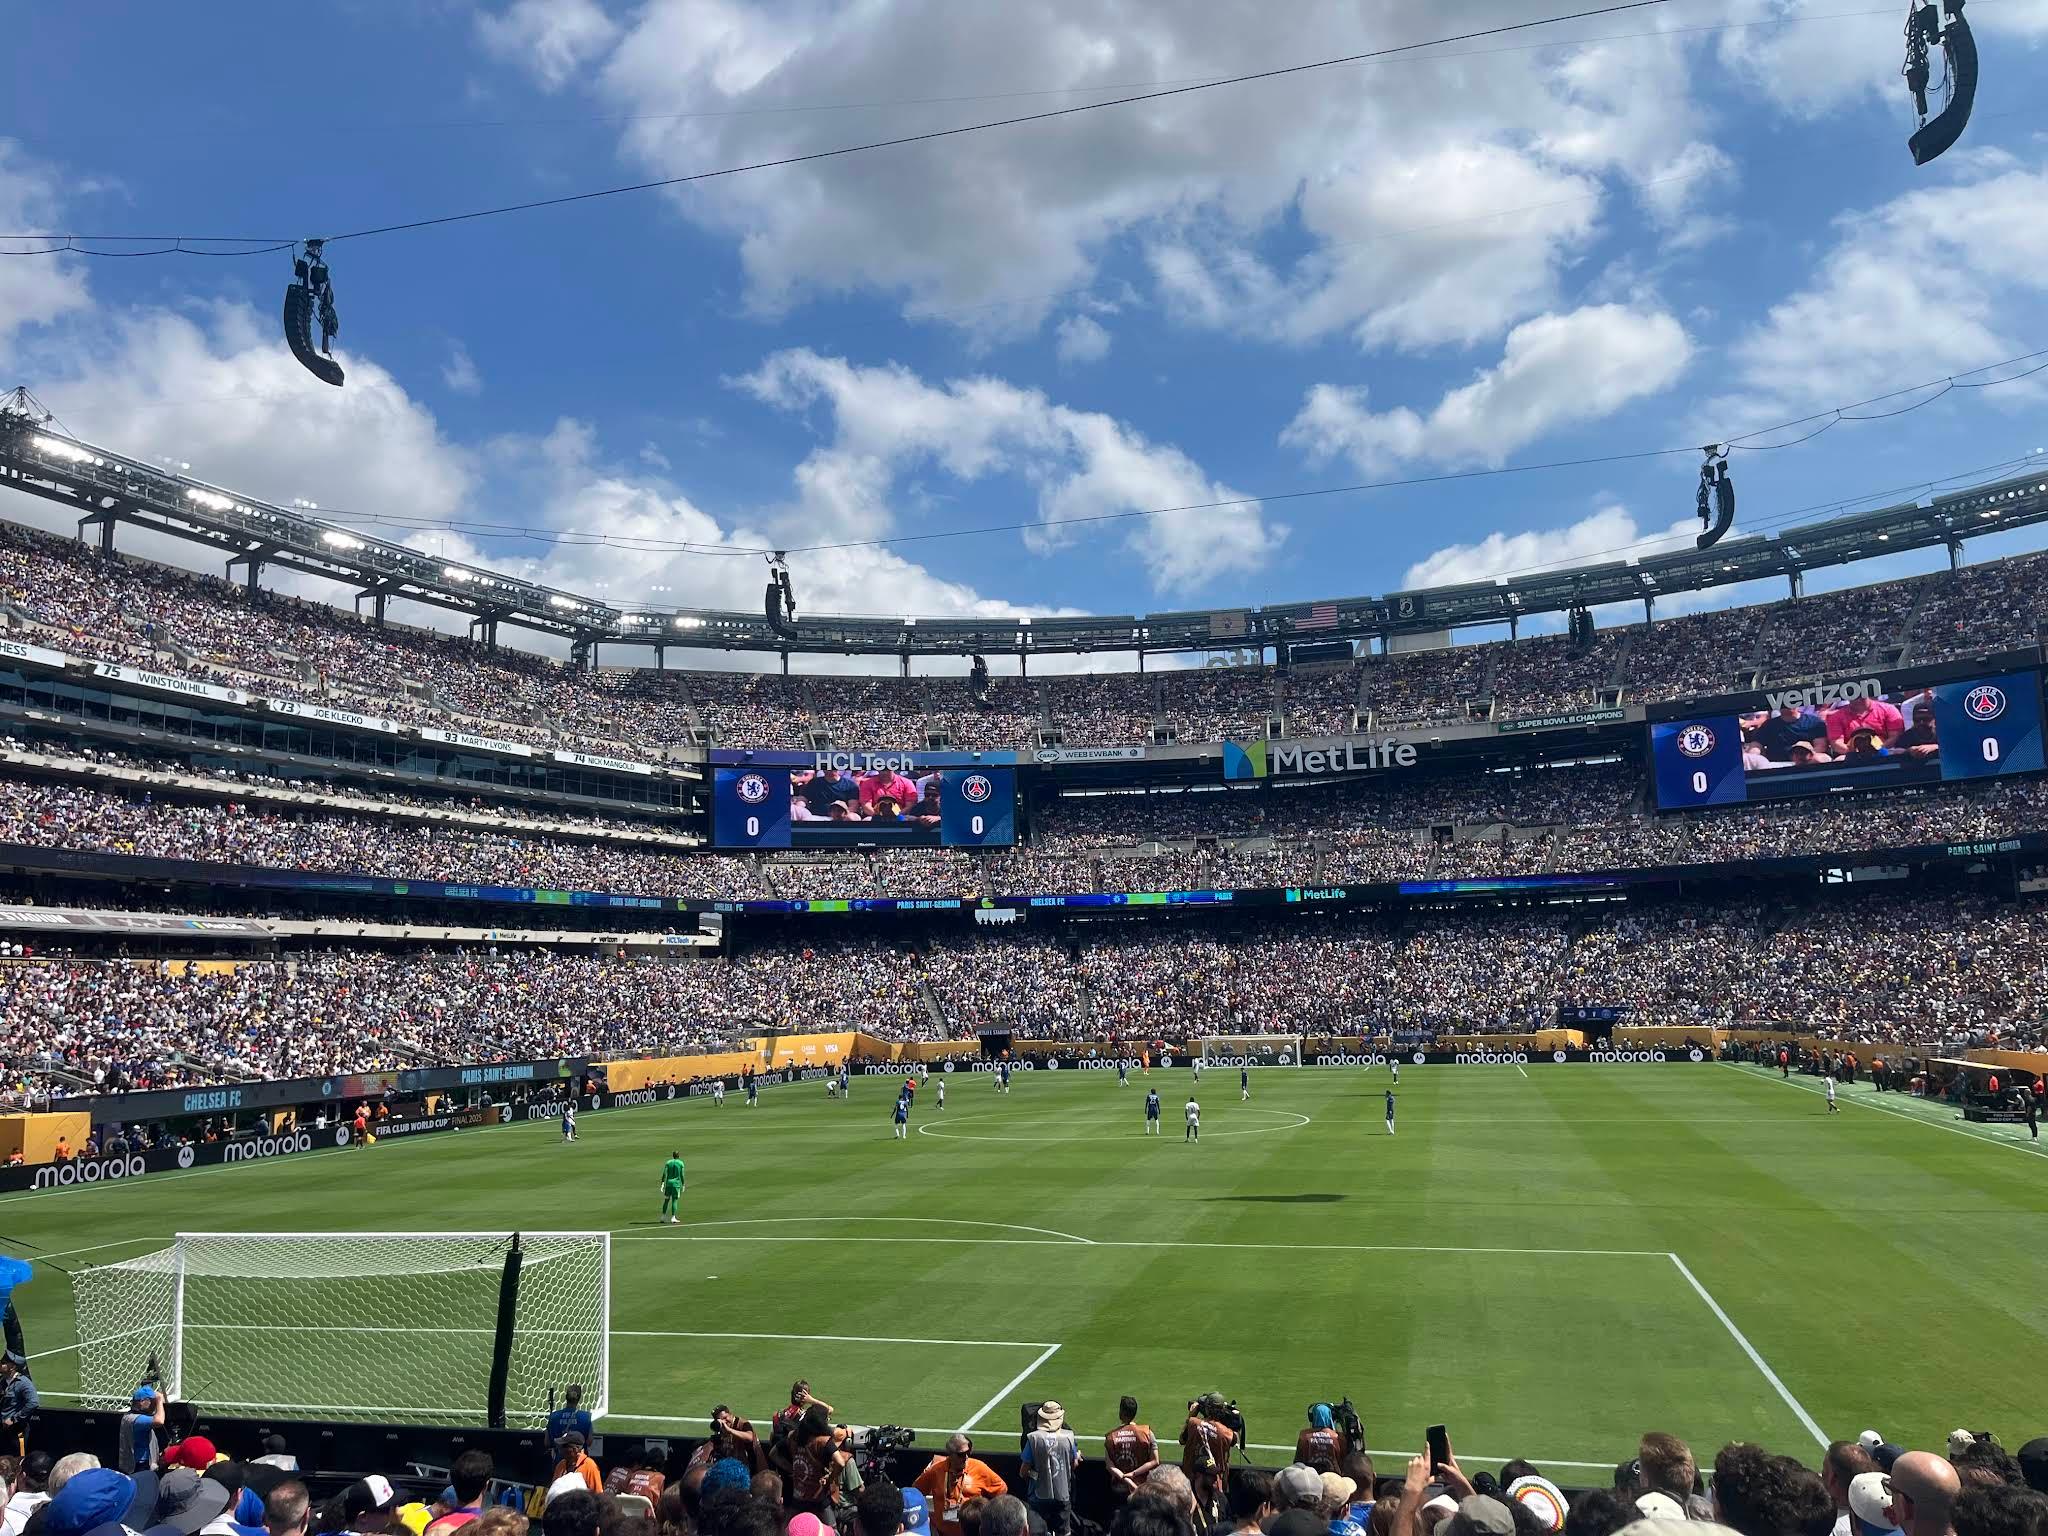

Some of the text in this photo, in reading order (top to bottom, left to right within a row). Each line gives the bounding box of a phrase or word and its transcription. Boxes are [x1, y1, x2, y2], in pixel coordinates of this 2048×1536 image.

[0, 641, 27, 657] HESS
[103, 664, 121, 678] 75
[138, 671, 209, 695] WINSTON HILL
[1765, 677, 1882, 711] verizon
[1970, 687, 1998, 699] PARIS
[279, 701, 295, 713] 73
[313, 709, 363, 725] JOE KLECKO
[1517, 719, 1542, 729] SUPER
[1544, 717, 1568, 726] BOWL
[1576, 711, 1623, 722] CHAMPIONS
[444, 732, 458, 743] 93
[461, 736, 512, 751] MARTY LYONS
[1089, 750, 1123, 758] EWBANK
[1273, 737, 1418, 775] MetLife
[1982, 737, 1999, 761] 0
[573, 753, 585, 764] 74
[588, 757, 635, 771] NICK MANGOLD
[815, 753, 914, 771] HCLTech
[1693, 771, 1708, 793] 0
[747, 816, 759, 836] 0
[972, 815, 983, 835] 0
[1947, 846, 1971, 856] PARIS
[1304, 888, 1346, 900] MetLife
[736, 903, 743, 912] FC
[896, 900, 960, 910] PARIS SAINT-GERMAIN
[1030, 898, 1056, 906] CHELSEA
[2, 911, 71, 925] STADIUM
[499, 932, 517, 940] MetLife
[824, 1044, 838, 1053] VISA
[1589, 1049, 1665, 1062] motorola
[1316, 1053, 1386, 1066] motorola
[1455, 1050, 1528, 1064] motorola
[461, 1065, 534, 1083] PARIS SAINT-GERMAIN
[184, 1090, 241, 1111] CHELSEA FC
[615, 1088, 657, 1107] motorola
[376, 1125, 393, 1135] FIFA
[393, 1123, 410, 1134] CLUB
[411, 1121, 431, 1132] WORLD
[451, 1115, 468, 1126] FINAL
[468, 1114, 483, 1124] 2025
[224, 1132, 312, 1163] motorola
[34, 1155, 146, 1188] motorola
